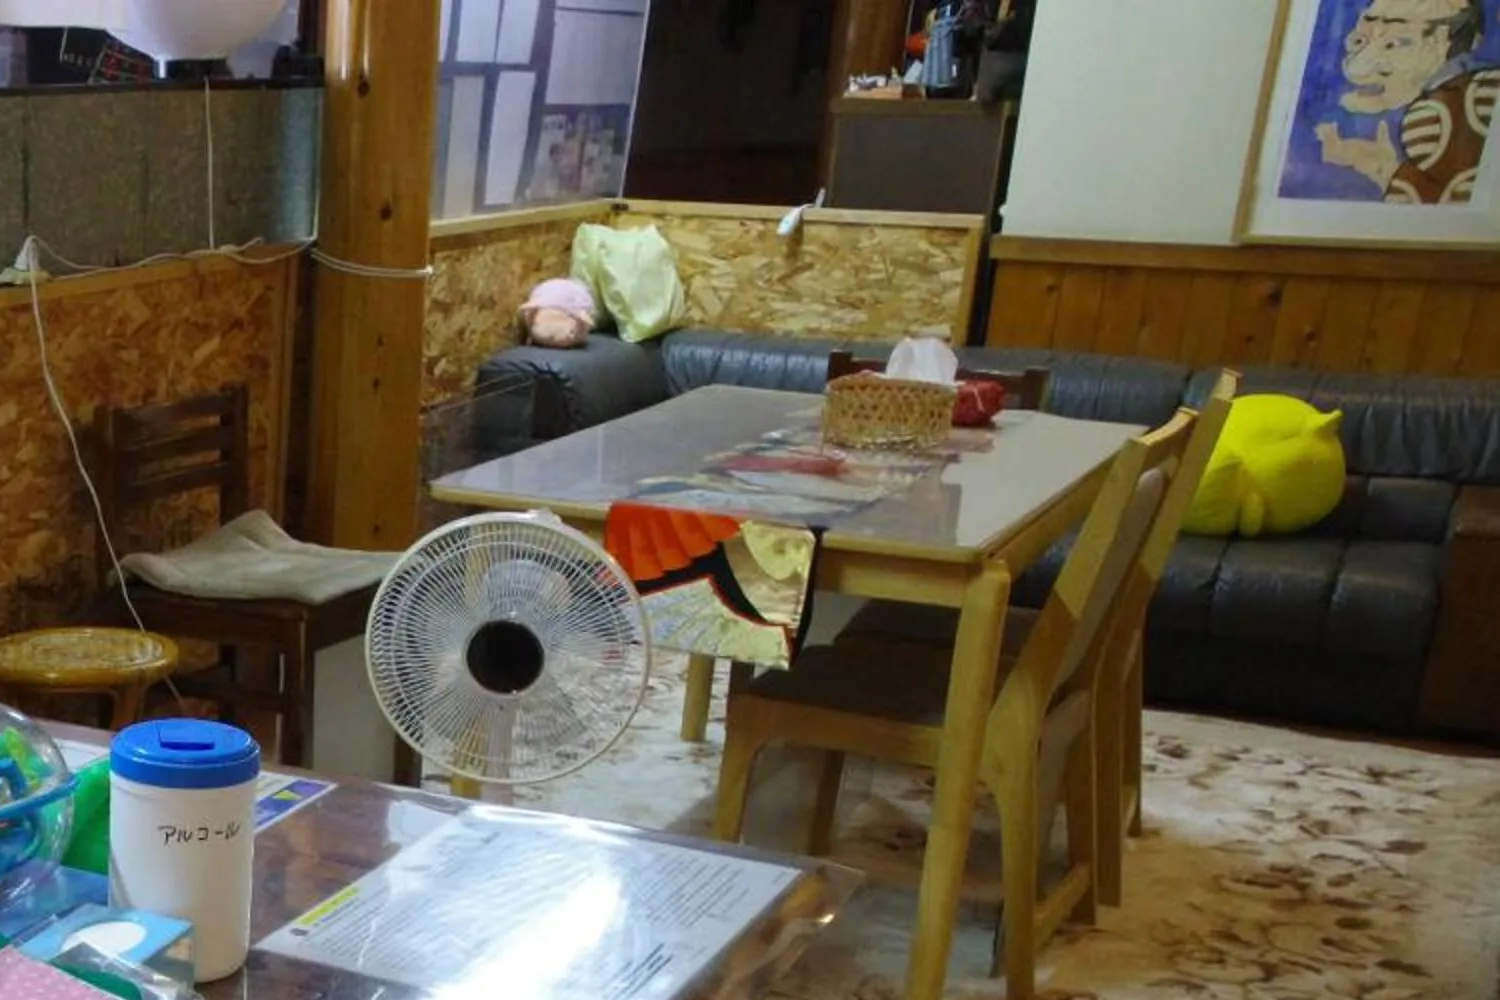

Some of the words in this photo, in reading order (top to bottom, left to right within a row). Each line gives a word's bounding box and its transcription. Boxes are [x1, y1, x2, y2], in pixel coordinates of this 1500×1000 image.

[158, 822, 241, 845] アルコール
